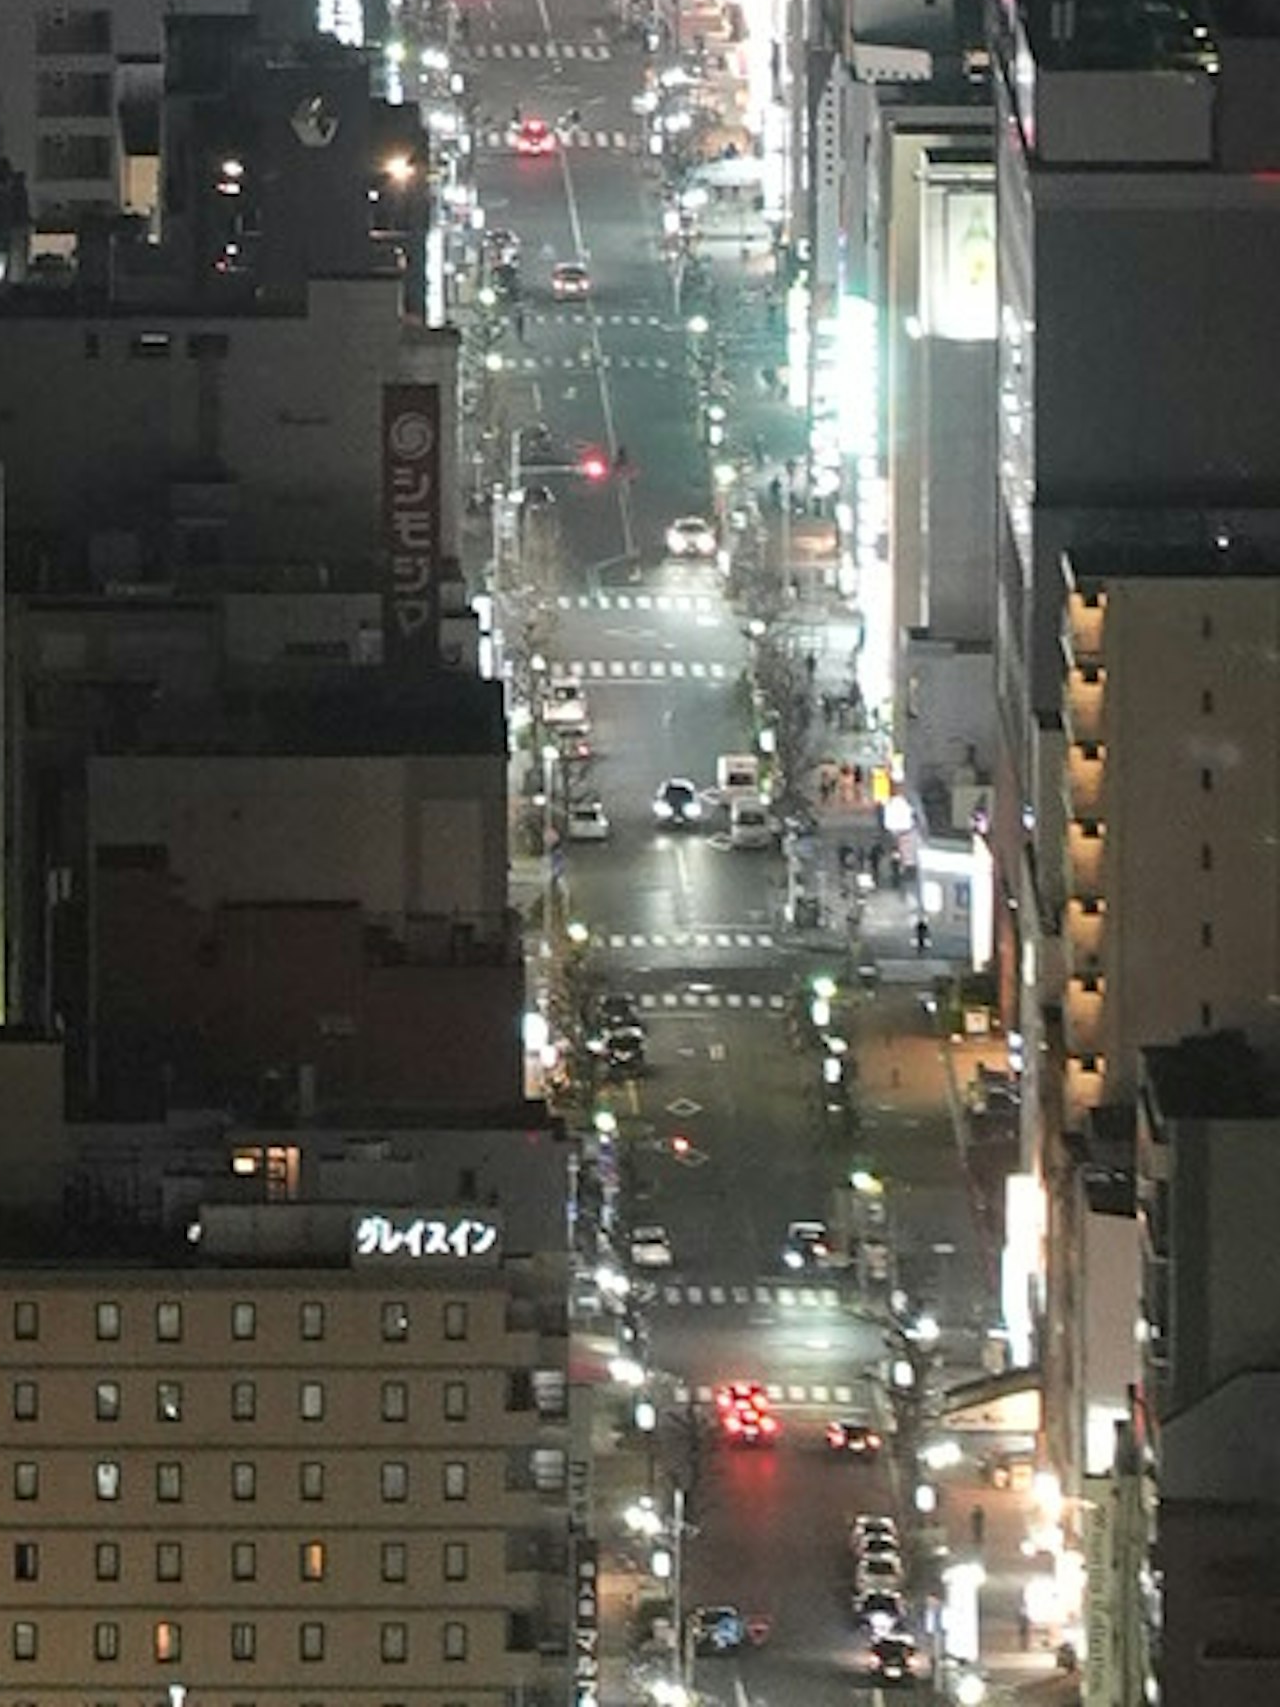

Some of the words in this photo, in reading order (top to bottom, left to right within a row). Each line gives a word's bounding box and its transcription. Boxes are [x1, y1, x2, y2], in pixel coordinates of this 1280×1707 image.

[356, 1215, 497, 1258] グレイスイン
